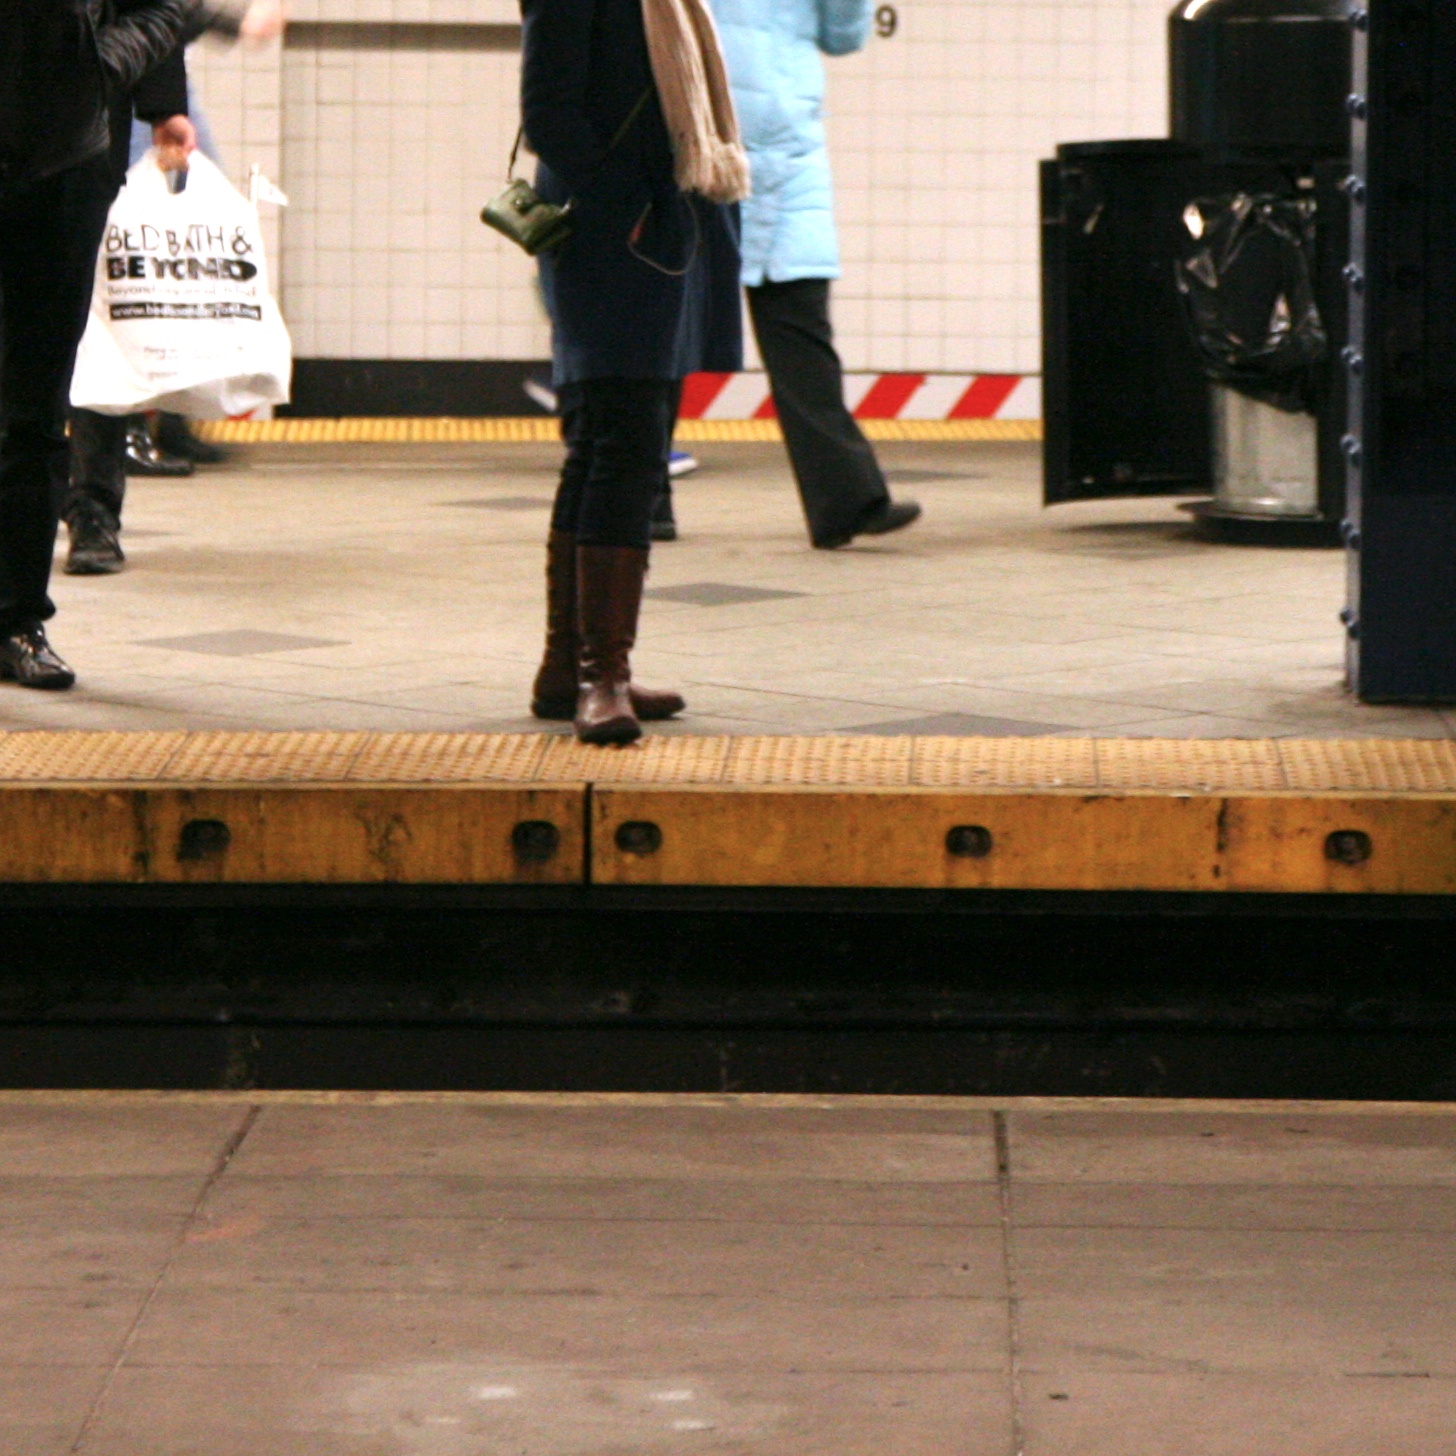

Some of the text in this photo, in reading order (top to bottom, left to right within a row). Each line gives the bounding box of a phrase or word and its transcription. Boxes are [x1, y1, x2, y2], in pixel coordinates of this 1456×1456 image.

[106, 224, 254, 256] BED BATH &
[105, 255, 258, 282] BEYOND
